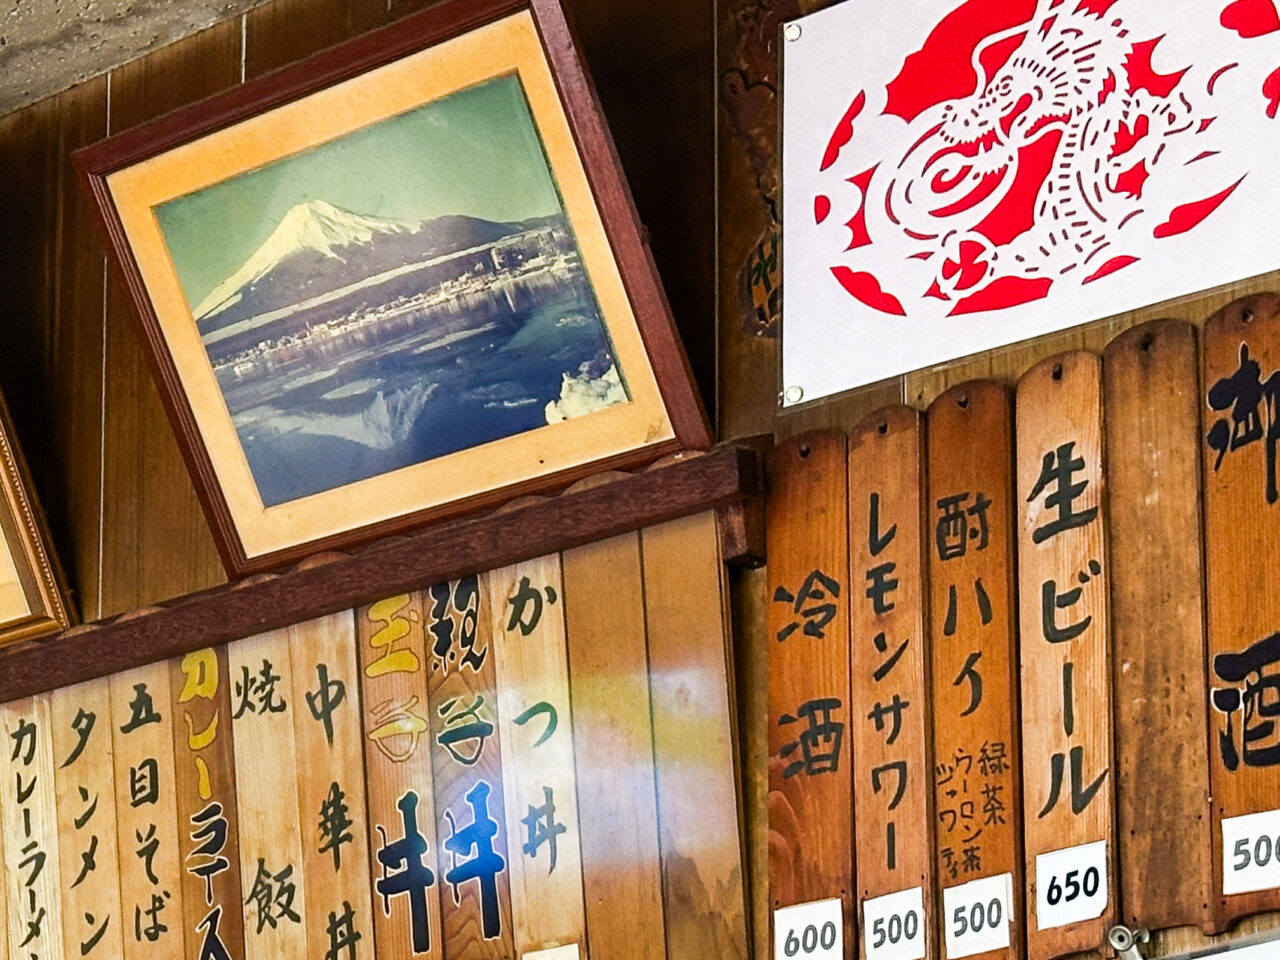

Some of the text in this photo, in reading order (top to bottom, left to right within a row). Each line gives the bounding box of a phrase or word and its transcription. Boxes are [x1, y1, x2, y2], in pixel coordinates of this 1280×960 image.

[773, 569, 844, 781] 冷酒
[865, 492, 910, 870] レモンサワー
[936, 491, 993, 718] 酎ハイ
[1026, 440, 1109, 820] 生ビール
[59, 707, 111, 957] タンメン
[119, 682, 173, 943] 五目そば
[232, 659, 302, 935] 焼飯
[428, 573, 506, 942] 親子丼
[507, 575, 567, 876] かつ丼
[977, 740, 1010, 826] 緑茶
[783, 920, 837, 957] 600
[872, 910, 918, 948] 500
[952, 898, 1003, 938] 500
[1046, 864, 1100, 906] 650
